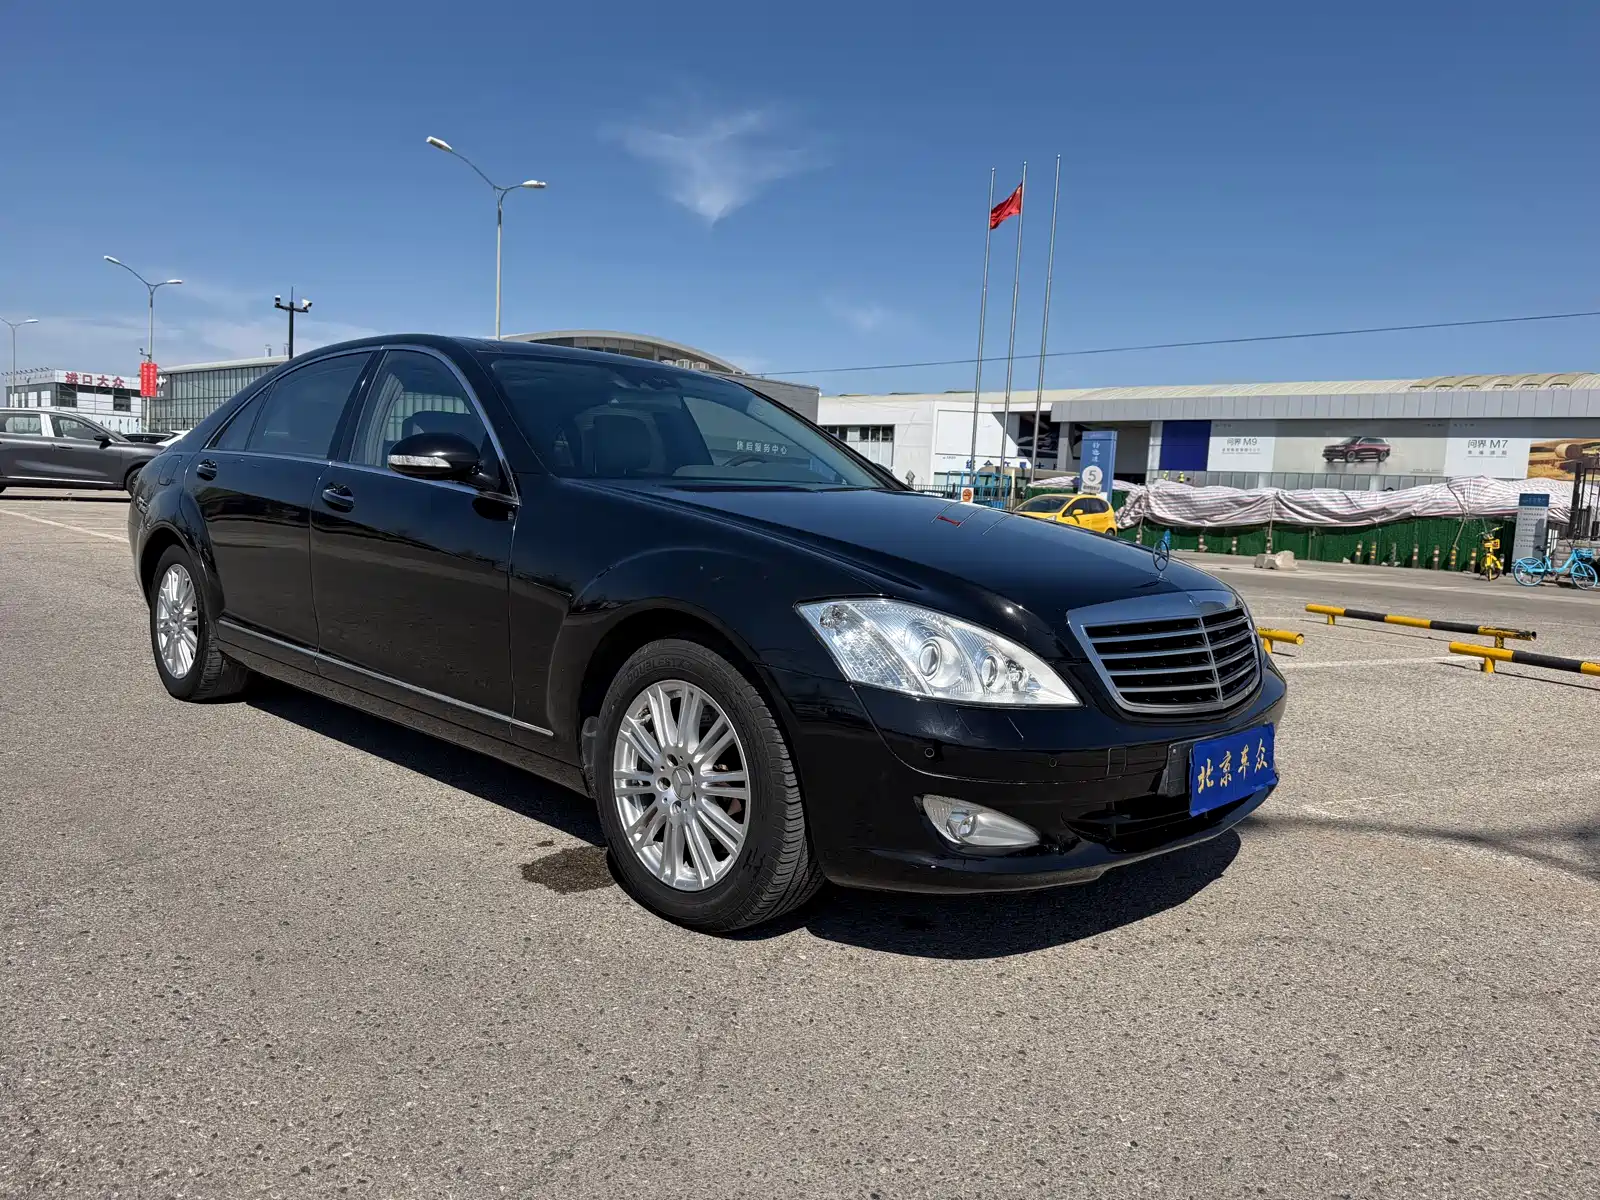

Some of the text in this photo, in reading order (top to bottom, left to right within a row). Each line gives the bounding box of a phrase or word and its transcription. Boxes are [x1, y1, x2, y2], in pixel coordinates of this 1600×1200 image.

[65, 372, 125, 388] 进口大众
[736, 440, 788, 455] 售后服务中心
[1242, 438, 1257, 446] M9
[1467, 439, 1508, 448] 问界 M7
[1088, 469, 1097, 482] 5
[1197, 738, 1268, 794] 北京车众
